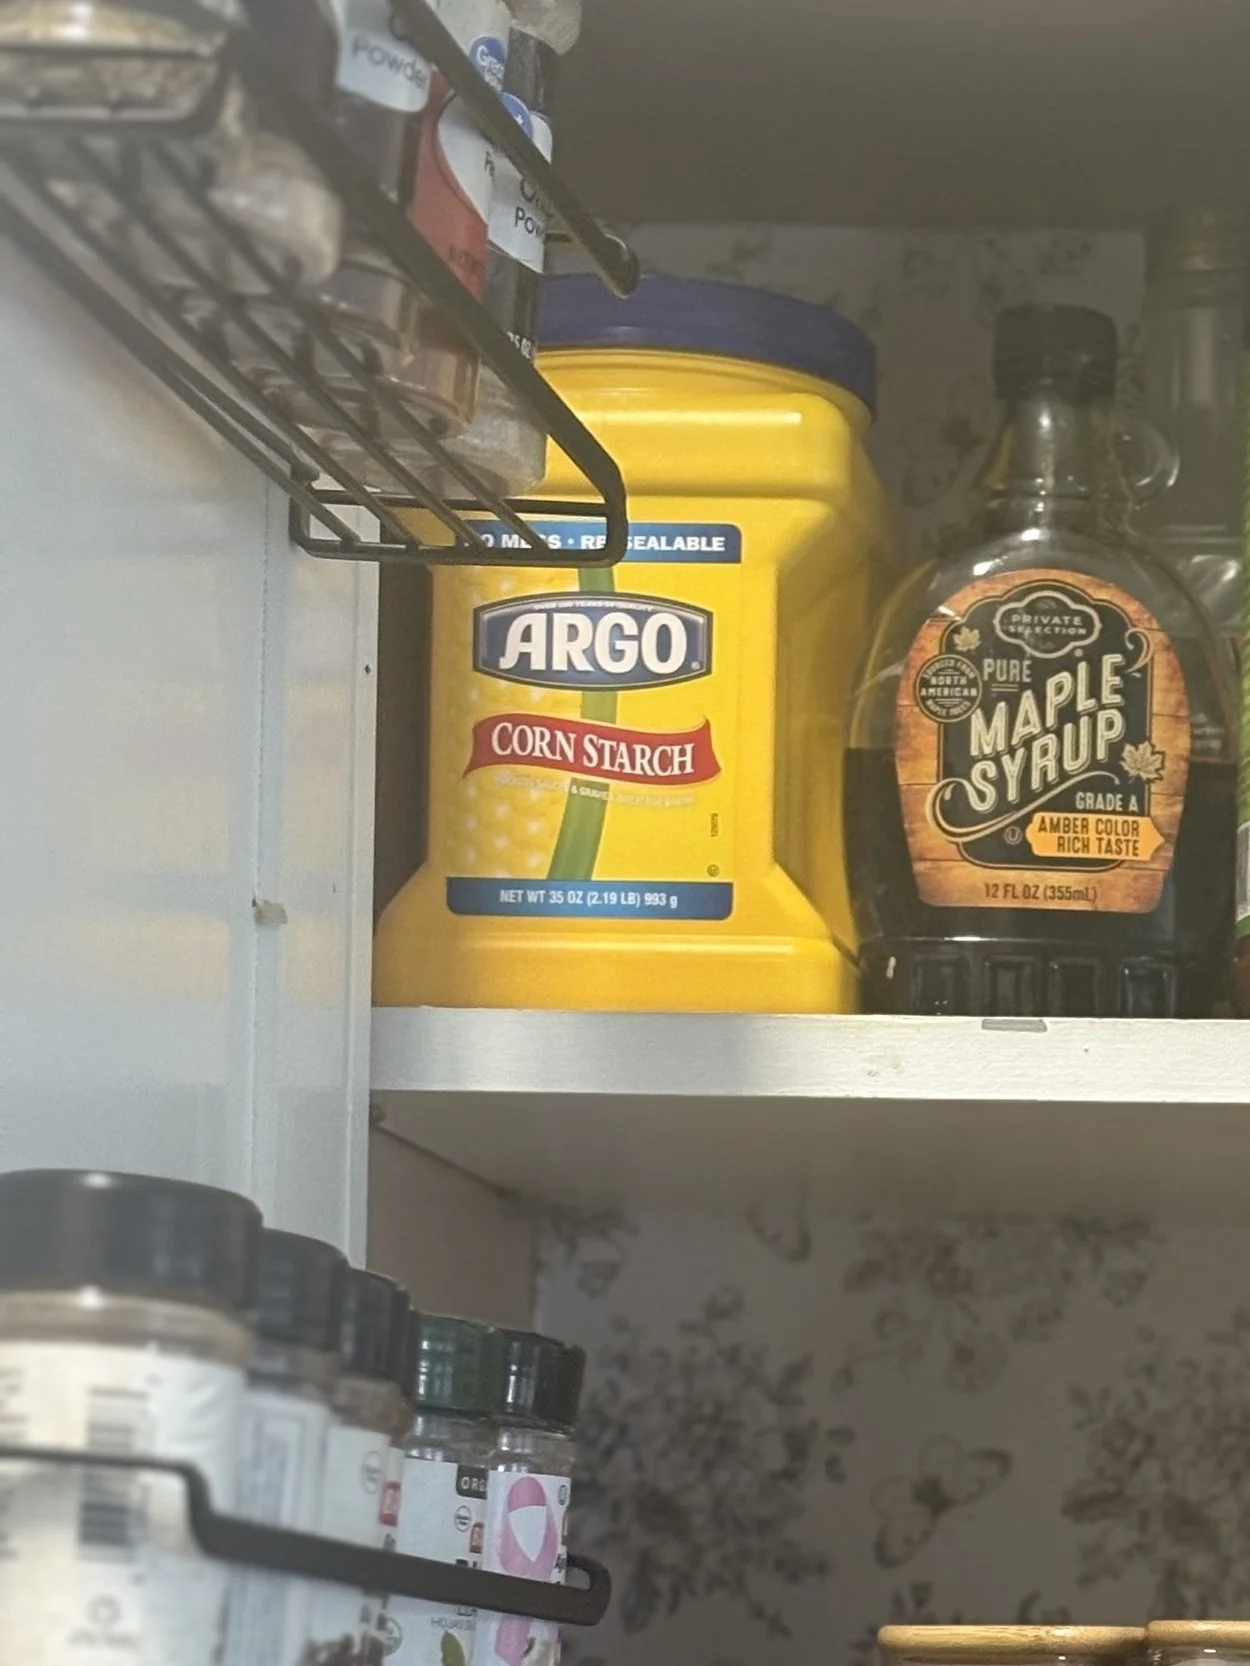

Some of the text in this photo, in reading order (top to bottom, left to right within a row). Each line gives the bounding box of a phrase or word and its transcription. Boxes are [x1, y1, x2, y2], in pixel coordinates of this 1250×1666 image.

[1008, 625, 1087, 635] SELECTION
[1011, 614, 1083, 626] PRIVATE
[500, 612, 687, 674] ARGO
[930, 675, 967, 685] NORTH
[983, 658, 1032, 683] PURE
[920, 687, 977, 697] AMERICAN
[970, 653, 1126, 759] MAPLE
[491, 722, 694, 776] CORN STARCH
[969, 708, 1126, 813] SYRUP
[1075, 791, 1139, 812] GRADE A
[1038, 816, 1140, 837] AMBER COLOR
[1057, 836, 1139, 857] RICH TASTE
[500, 890, 678, 908] NET WT 35 OZ (2.19 LB) 993 g
[985, 883, 1097, 904] 12 FL OZ (355mL)
